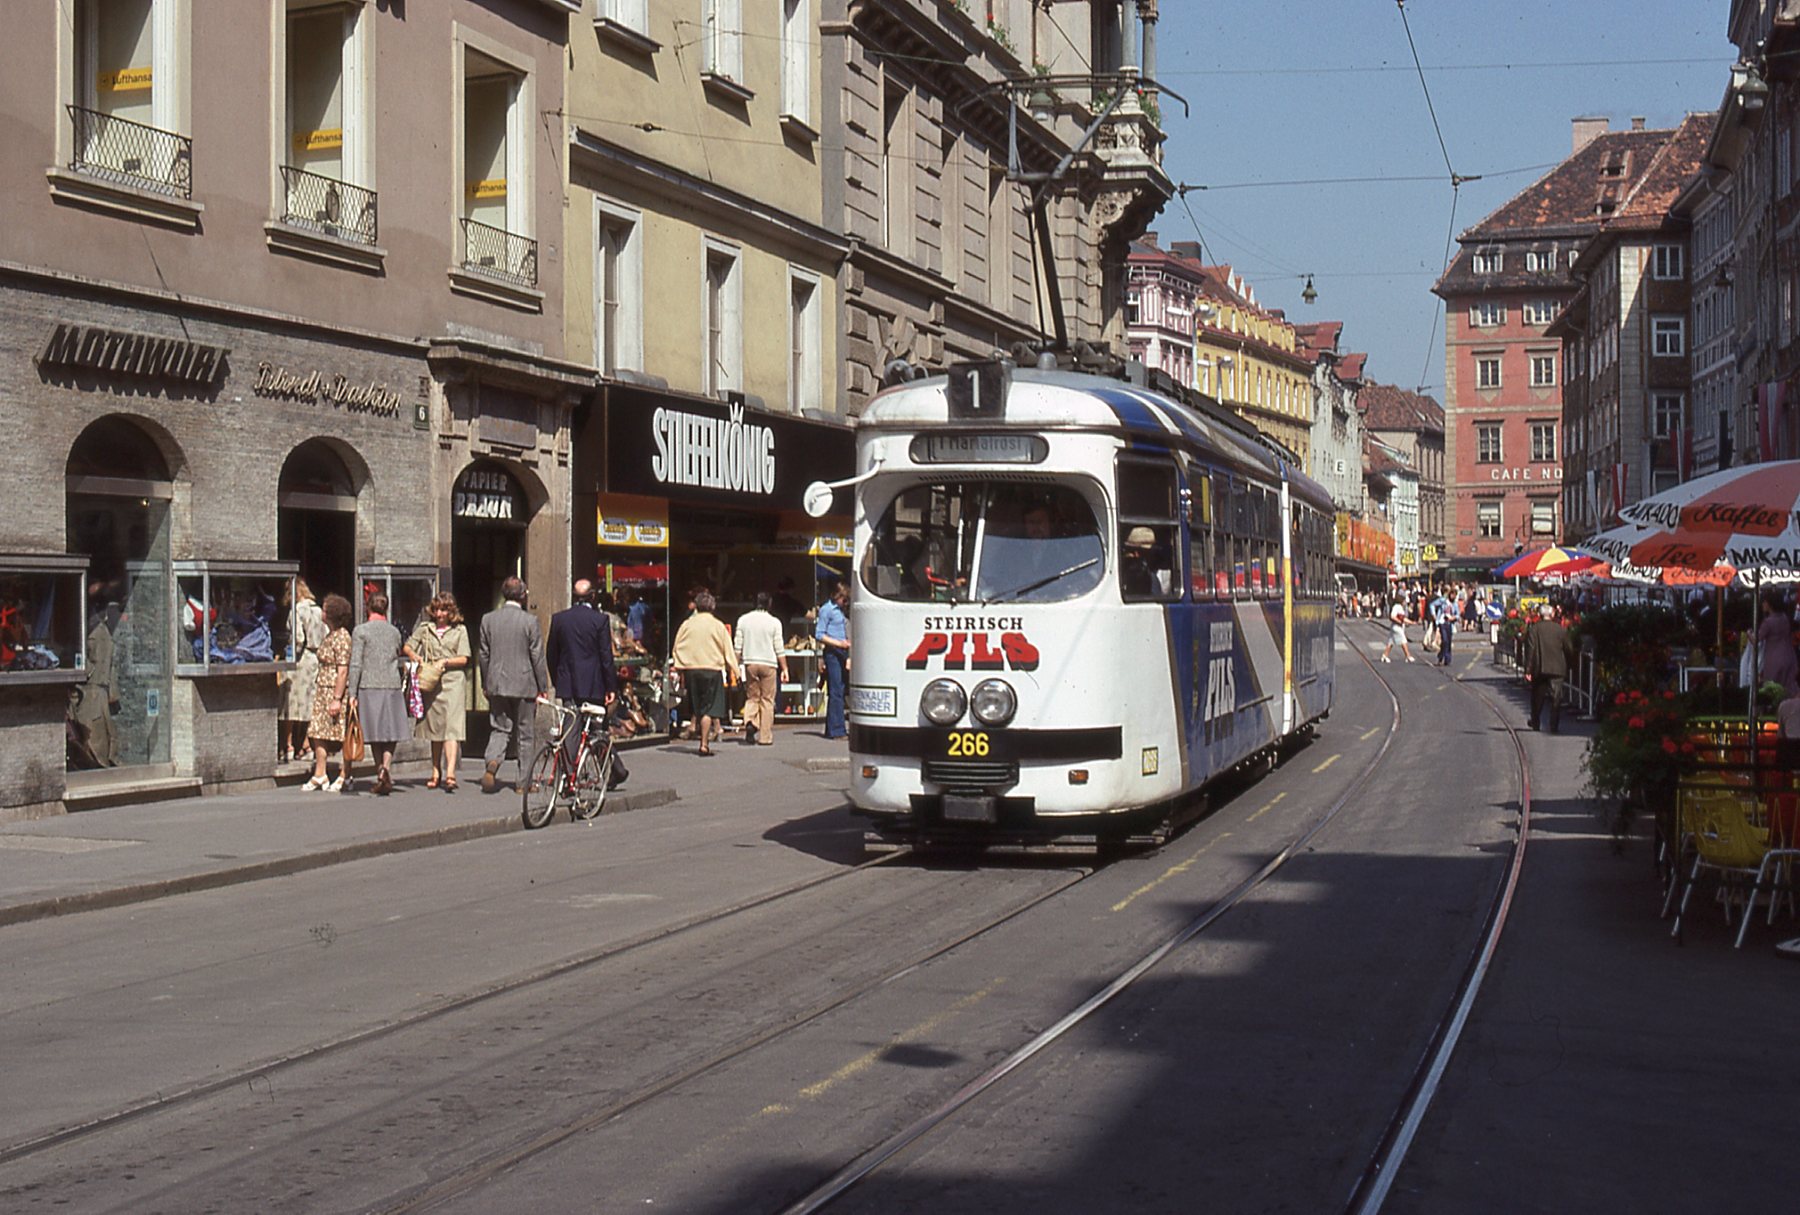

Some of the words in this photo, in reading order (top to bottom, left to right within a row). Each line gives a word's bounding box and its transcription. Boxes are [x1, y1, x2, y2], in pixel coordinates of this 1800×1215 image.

[966, 370, 981, 408] 1
[418, 406, 426, 421] 6
[462, 471, 508, 492] PAPIER
[1491, 468, 1531, 481] CAFE
[454, 492, 513, 519] BRAUN
[1622, 503, 1679, 529] MIKADO
[1693, 502, 1781, 528] Kaffee
[1650, 543, 1697, 566] Tee
[1742, 567, 1800, 585] MKADO
[924, 617, 1023, 630] STEIRISCH
[906, 632, 1040, 672] PILS
[1204, 656, 1235, 746] PILS
[948, 732, 989, 756] 266
